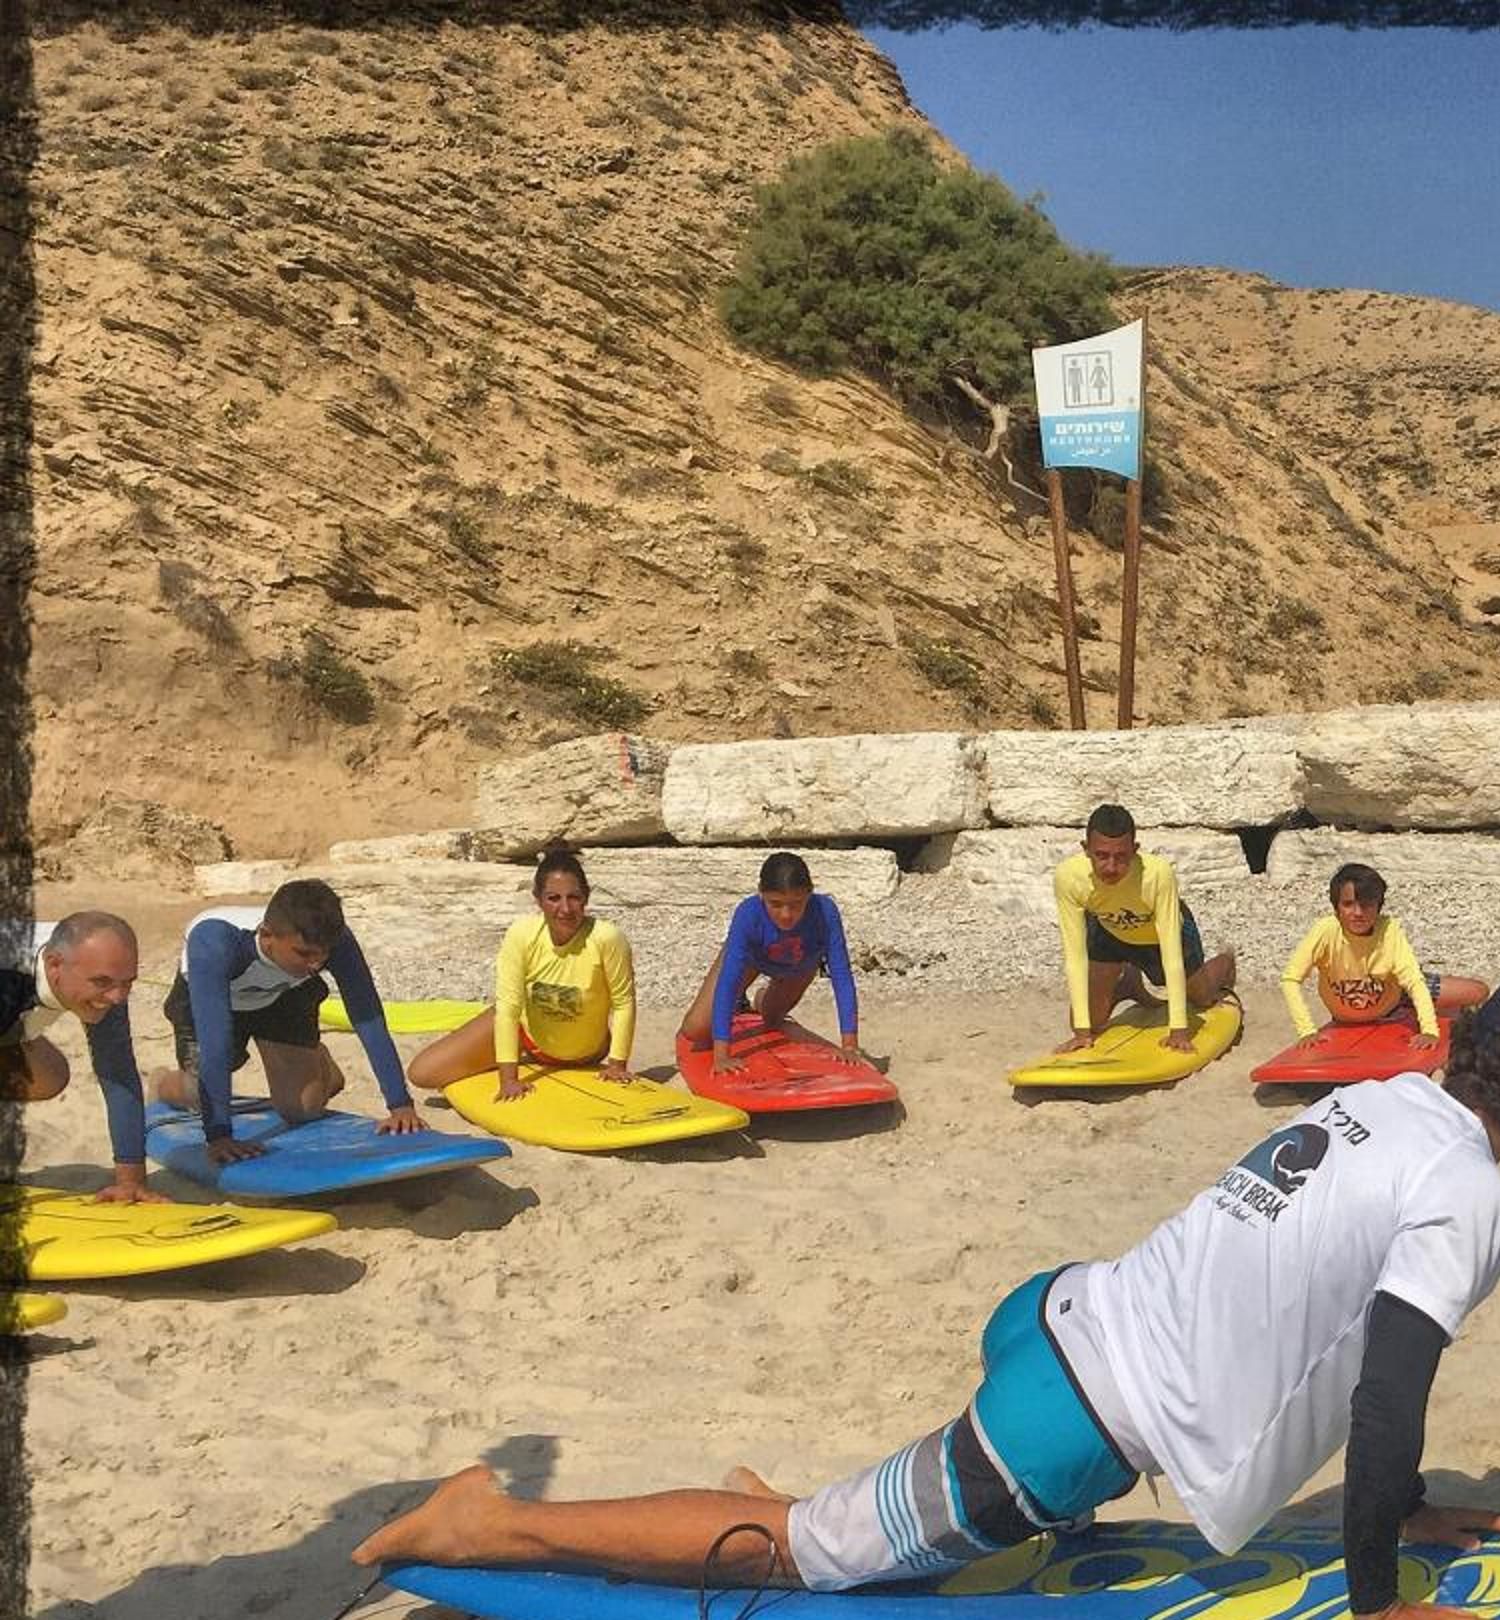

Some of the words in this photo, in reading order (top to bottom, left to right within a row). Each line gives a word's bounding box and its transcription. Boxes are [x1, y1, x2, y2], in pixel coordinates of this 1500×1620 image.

[1055, 420, 1125, 435] שירותים
[1320, 1099, 1371, 1146] מדריך
[1242, 1182, 1289, 1222] BREAK
